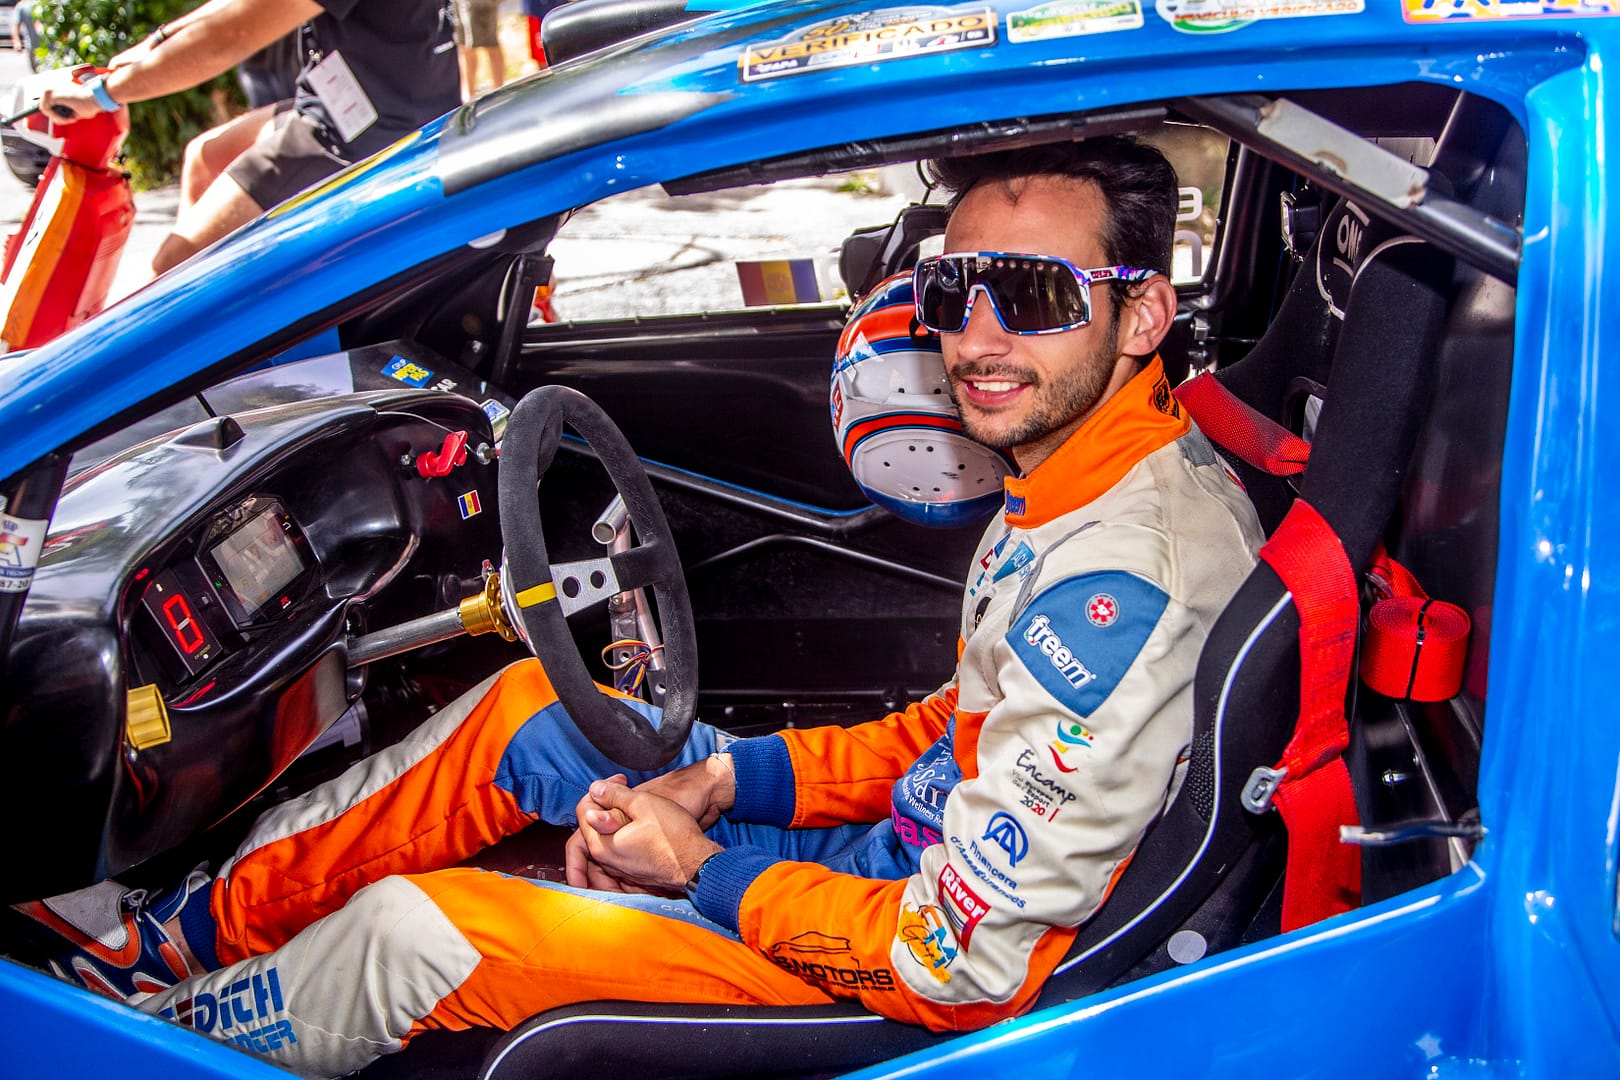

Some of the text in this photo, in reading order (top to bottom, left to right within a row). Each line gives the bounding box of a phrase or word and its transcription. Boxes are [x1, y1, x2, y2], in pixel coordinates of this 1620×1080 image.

[757, 16, 983, 61] VERIFICADO
[1024, 615, 1092, 688] freem
[1016, 749, 1077, 806] Encamp
[908, 795, 935, 820] Wellness
[1020, 795, 1046, 816] 2020
[941, 868, 985, 918] River
